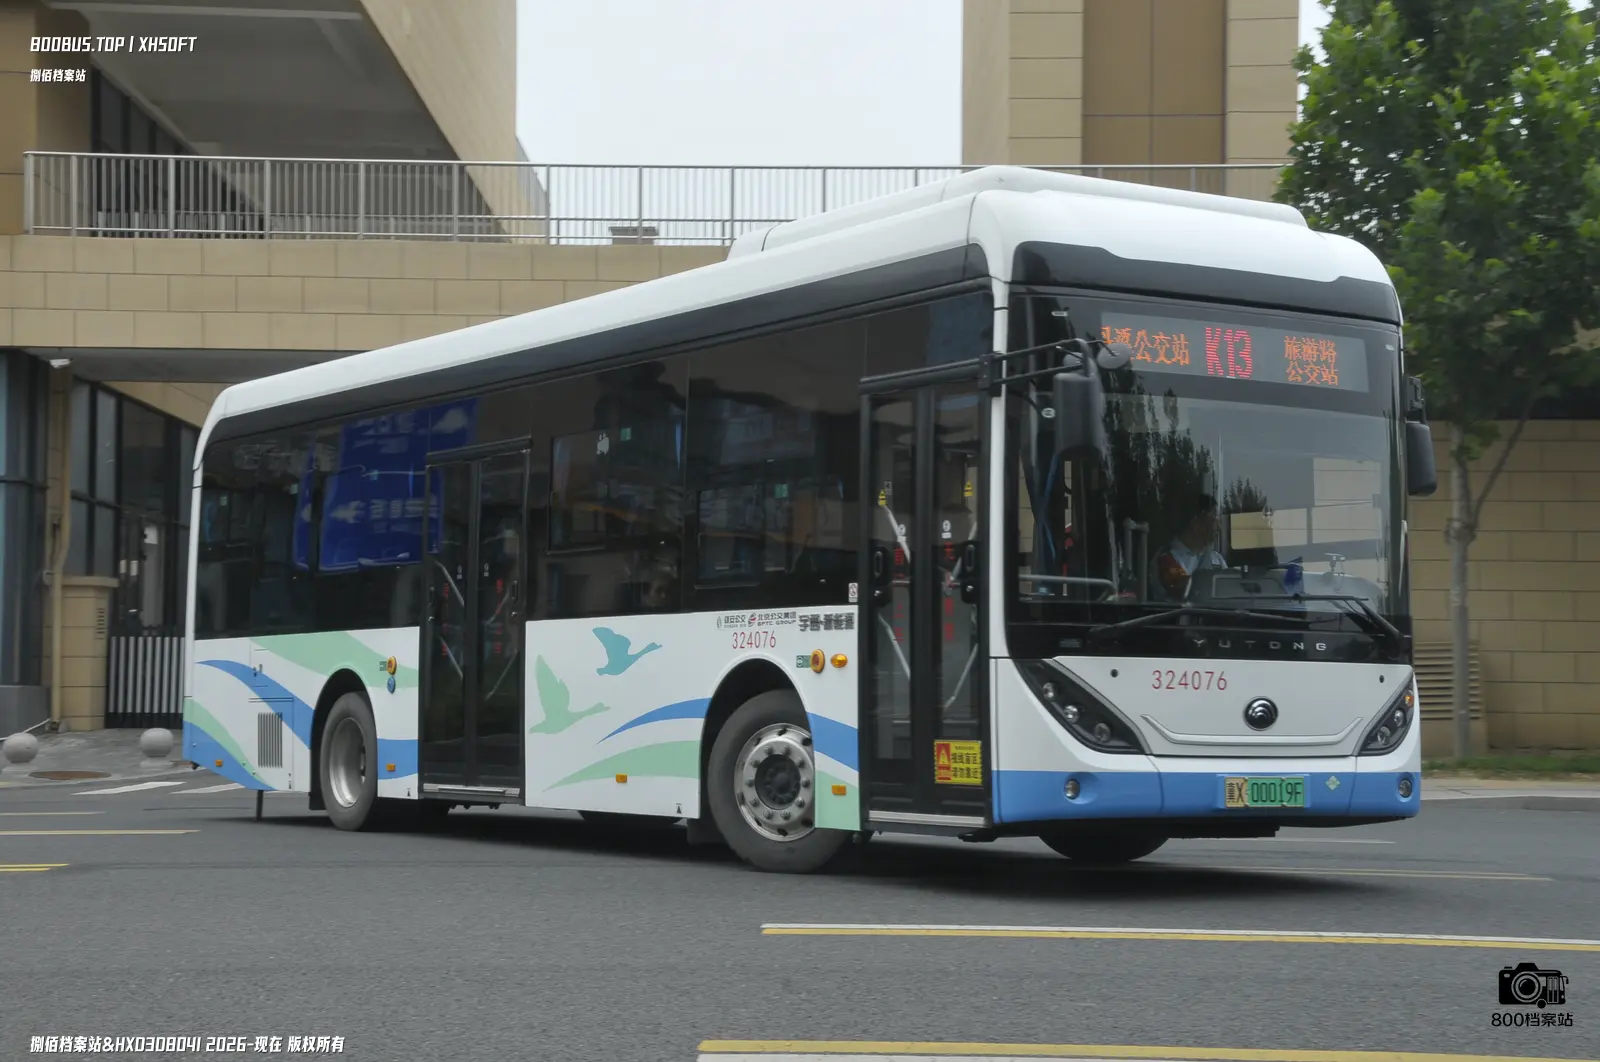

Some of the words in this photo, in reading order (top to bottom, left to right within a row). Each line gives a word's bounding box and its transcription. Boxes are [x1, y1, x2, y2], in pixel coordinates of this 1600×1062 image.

[1205, 327, 1253, 378] K13
[1284, 335, 1337, 363] 旅游路
[1286, 360, 1339, 386] 公交站
[732, 630, 776, 649] 324076
[1194, 639, 1327, 651] YUTONG
[1152, 670, 1228, 690] 324076
